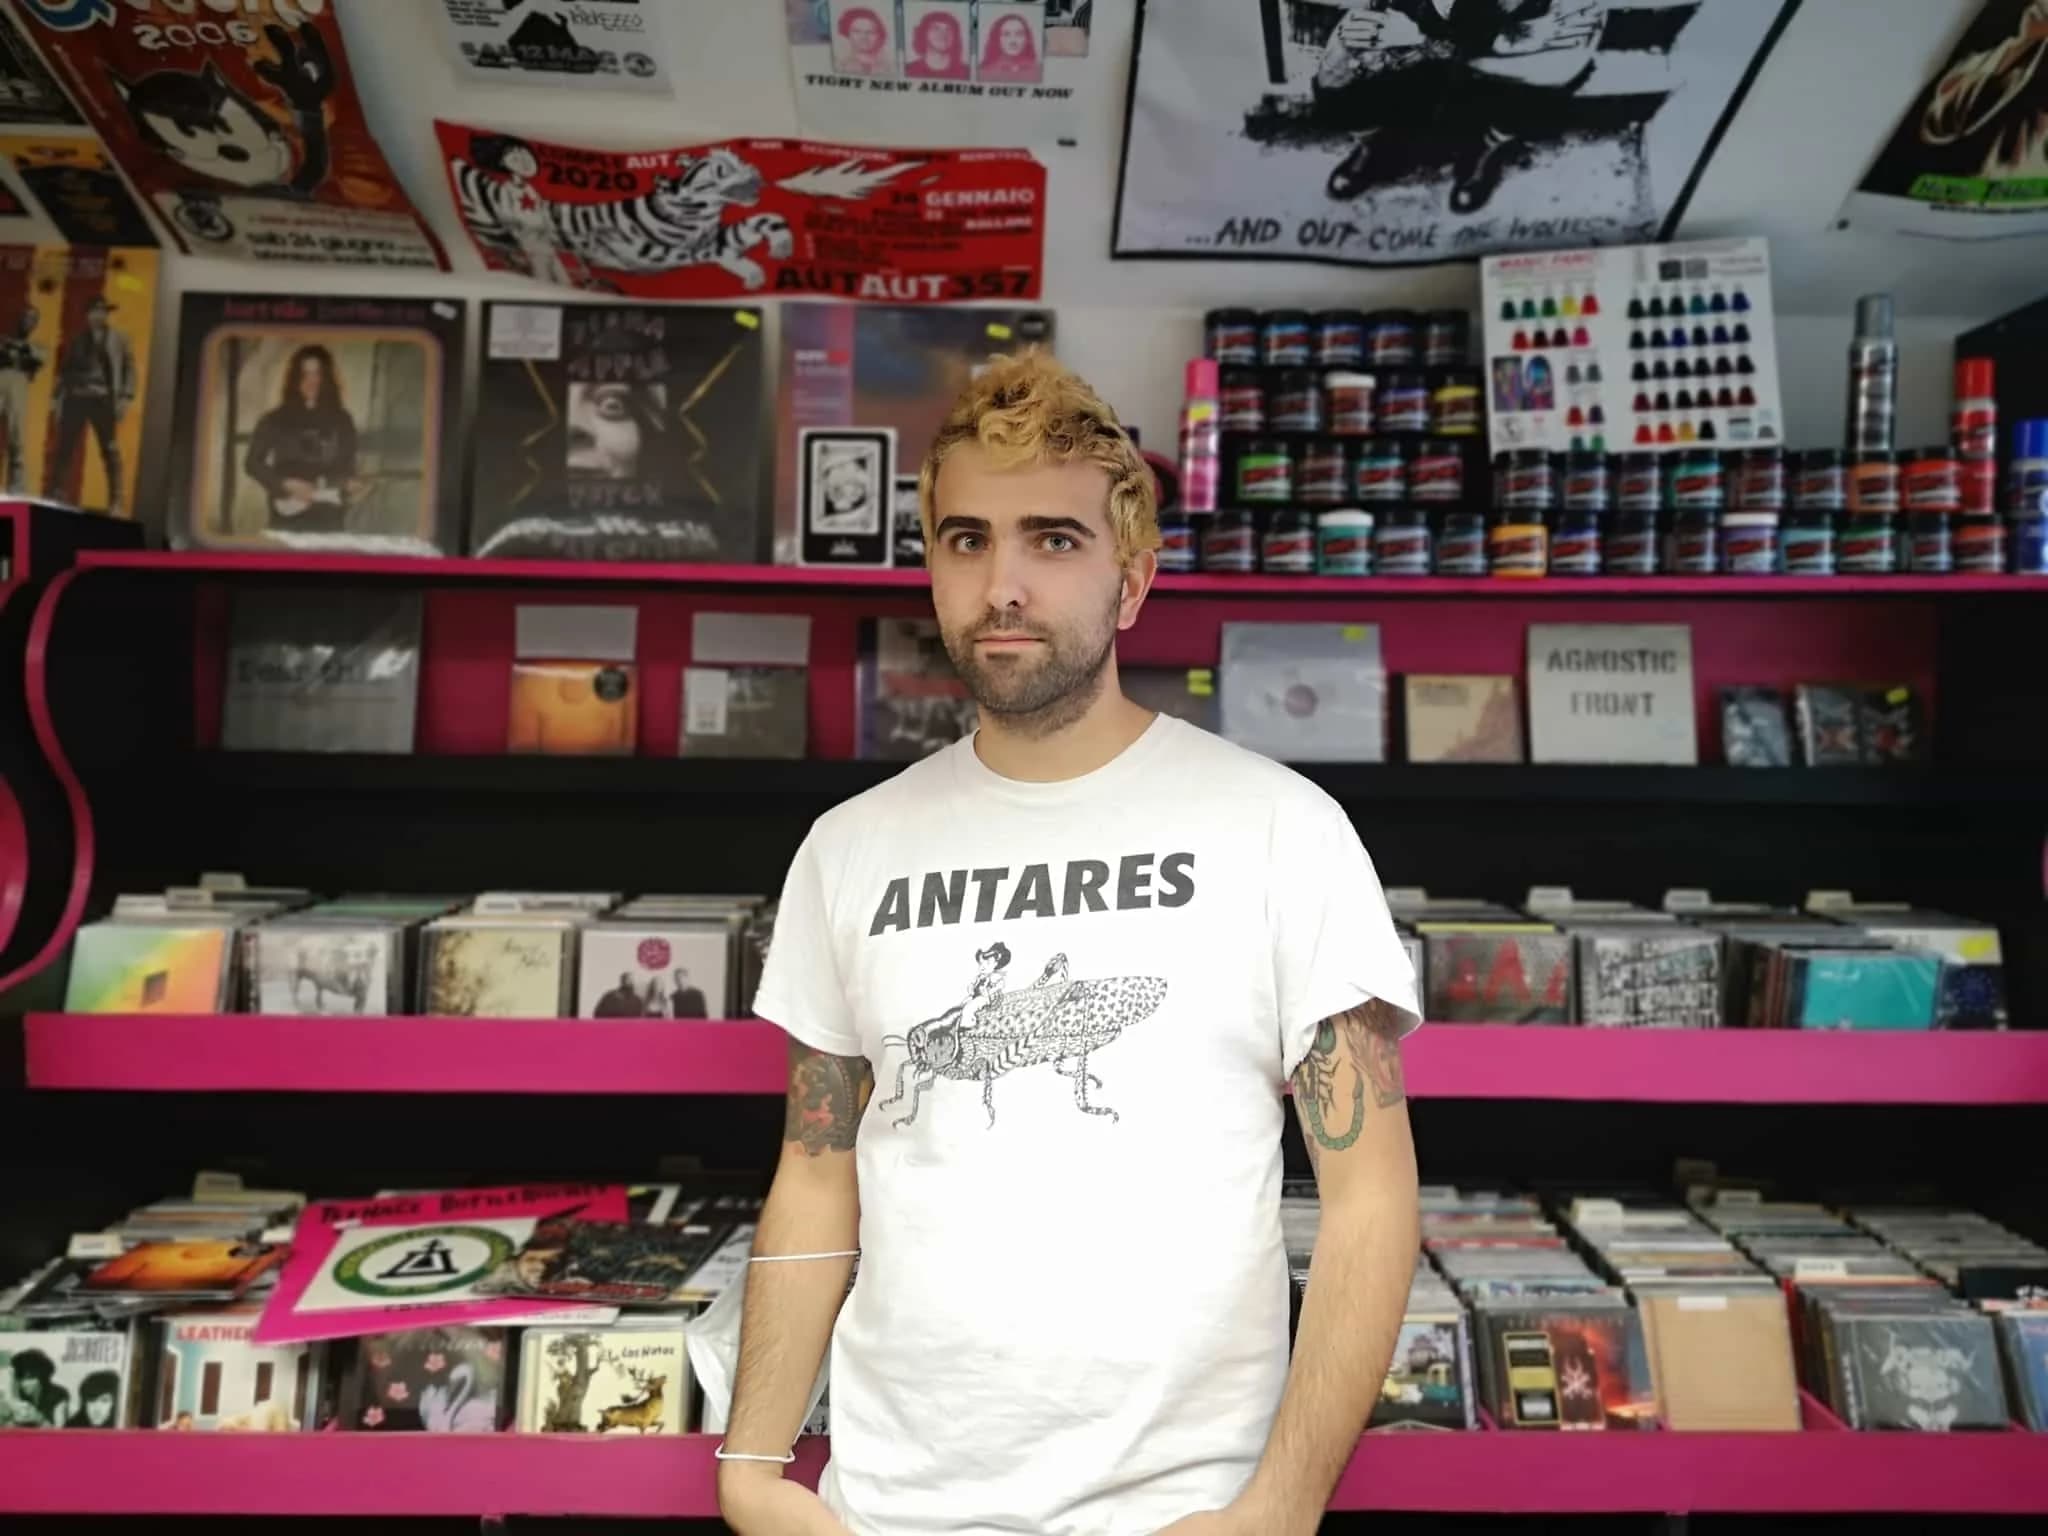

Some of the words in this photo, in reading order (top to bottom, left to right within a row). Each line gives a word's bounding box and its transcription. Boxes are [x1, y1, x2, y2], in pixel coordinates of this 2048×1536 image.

[806, 74, 864, 90] TIGHT
[870, 80, 912, 92] NEW
[918, 83, 984, 97] ALBUM
[989, 86, 1026, 98] OUT
[1032, 87, 1075, 99] NOW
[544, 162, 638, 192] 2020
[925, 188, 1034, 207] GENNAIO
[1297, 218, 1361, 247] OUT
[1368, 222, 1438, 251] COME
[1548, 649, 1677, 673] AGNOSTIC
[1572, 692, 1653, 716] FRONT
[869, 852, 1196, 937] ANTARES
